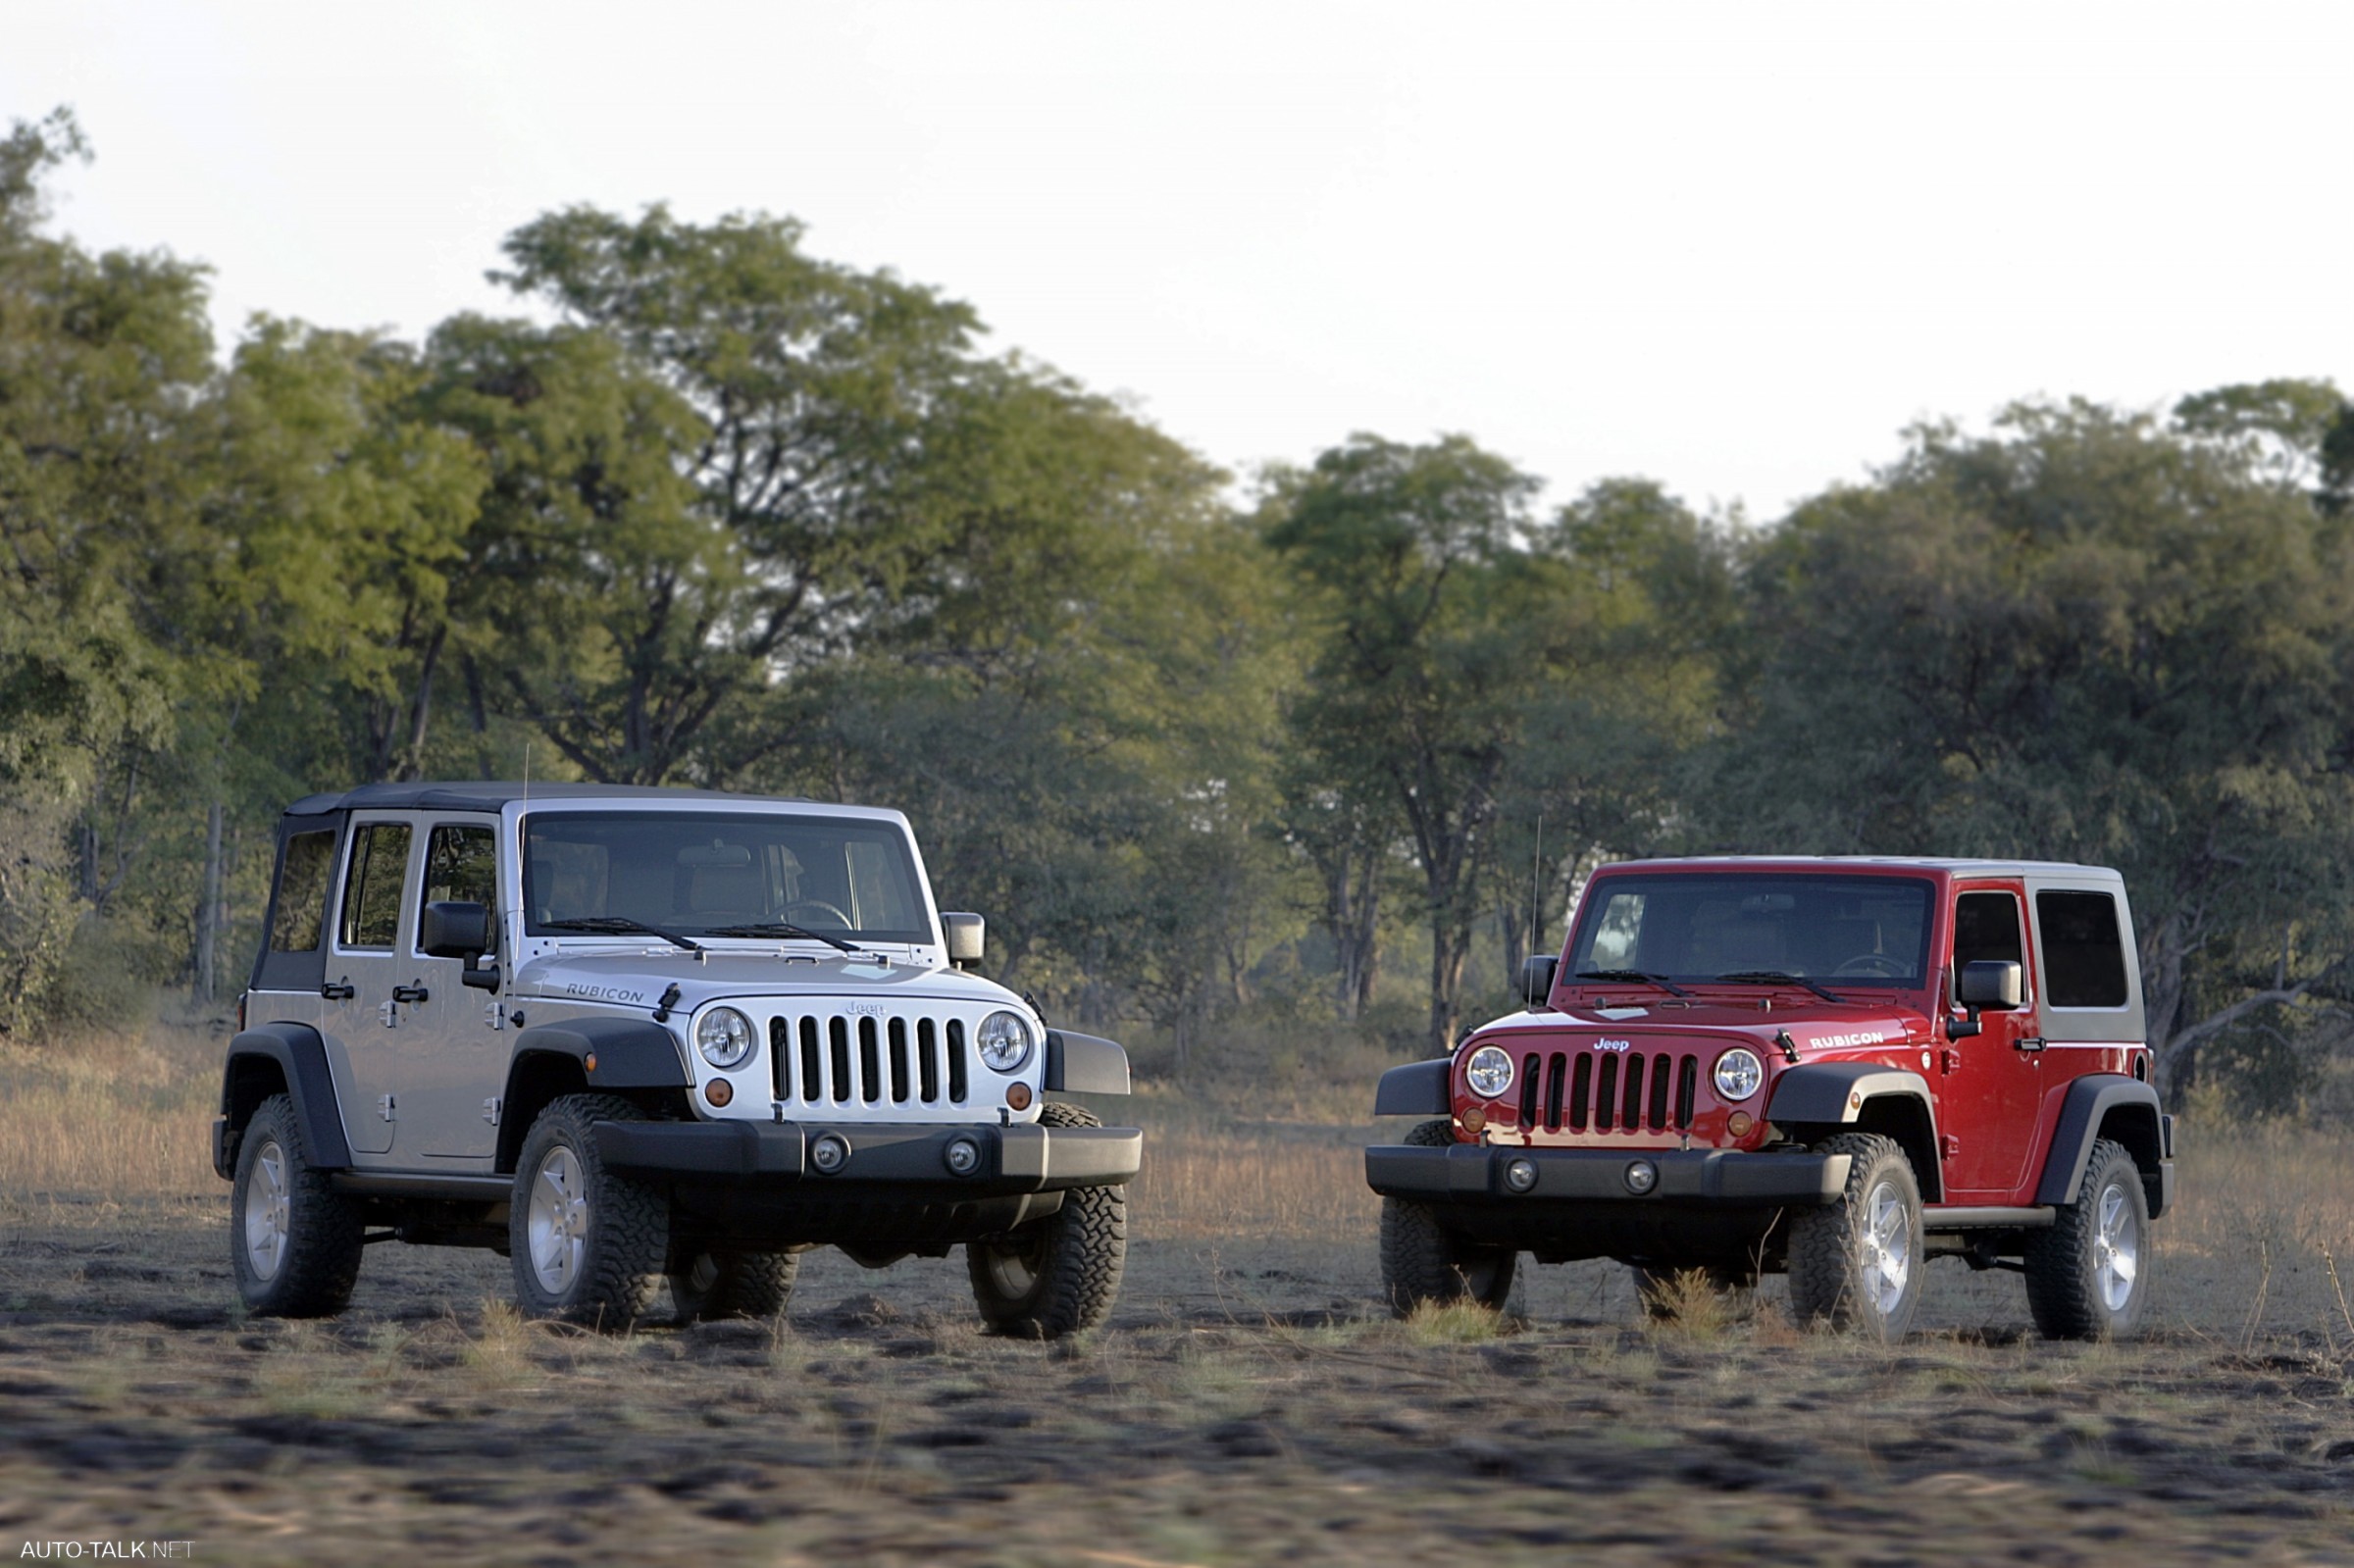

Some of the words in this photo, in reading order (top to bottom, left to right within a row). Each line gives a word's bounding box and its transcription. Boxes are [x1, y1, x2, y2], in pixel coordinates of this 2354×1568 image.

[566, 983, 644, 1002] RUBICON
[846, 1001, 887, 1018] Jeep
[1593, 1037, 1630, 1052] Jeep
[1809, 1032, 1884, 1049] RUBICON
